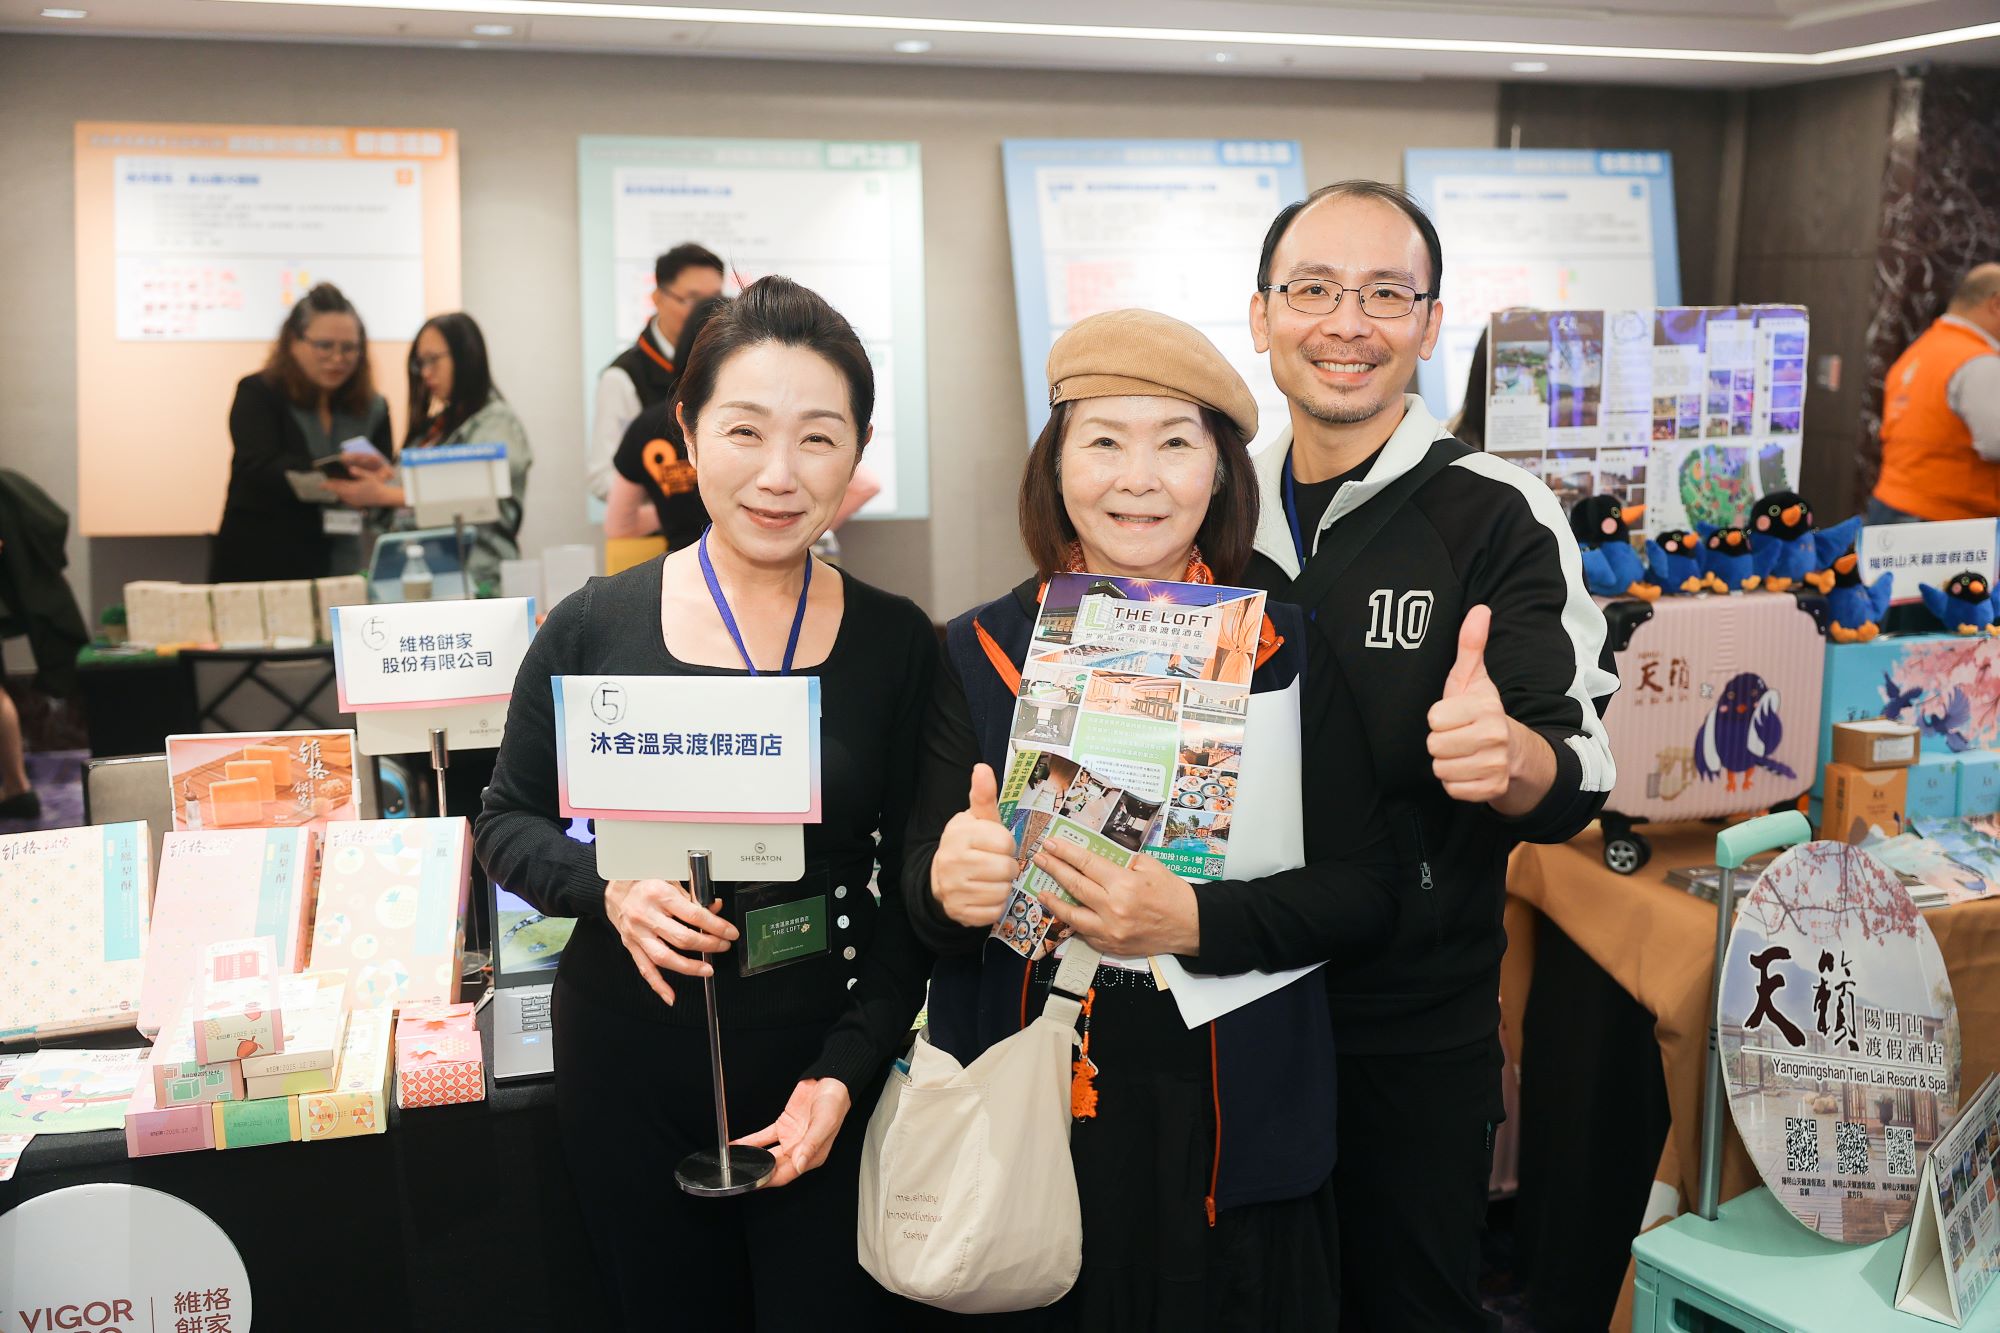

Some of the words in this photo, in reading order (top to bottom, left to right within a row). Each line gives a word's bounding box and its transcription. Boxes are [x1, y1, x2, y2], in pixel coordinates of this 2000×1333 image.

[1870, 550, 1987, 568] 陽明山天籟渡假酒店
[1114, 607, 1153, 622] THE
[1161, 612, 1213, 628] LOFT
[1115, 622, 1202, 638] 沐舍溫泉渡假酒店
[1365, 589, 1434, 649] 10
[400, 633, 472, 652] 維格餅家
[382, 651, 492, 674] 股份有限公司
[590, 732, 782, 756] 沐舍溫泉渡假酒店
[786, 924, 801, 933] LOFT
[1744, 946, 1860, 1052] 天籟
[1864, 1008, 1923, 1036] 陽明山
[1865, 1036, 1944, 1065] 渡假酒店
[1773, 1058, 1846, 1081] Yangmingshan
[1847, 1066, 1869, 1082] Tien
[1870, 1070, 1885, 1084] Lai
[1887, 1071, 1917, 1087] Resort
[1919, 1075, 1926, 1087] &
[1928, 1076, 1946, 1092] Spa
[174, 1287, 232, 1315] 維格
[18, 1299, 135, 1333] VIGOR
